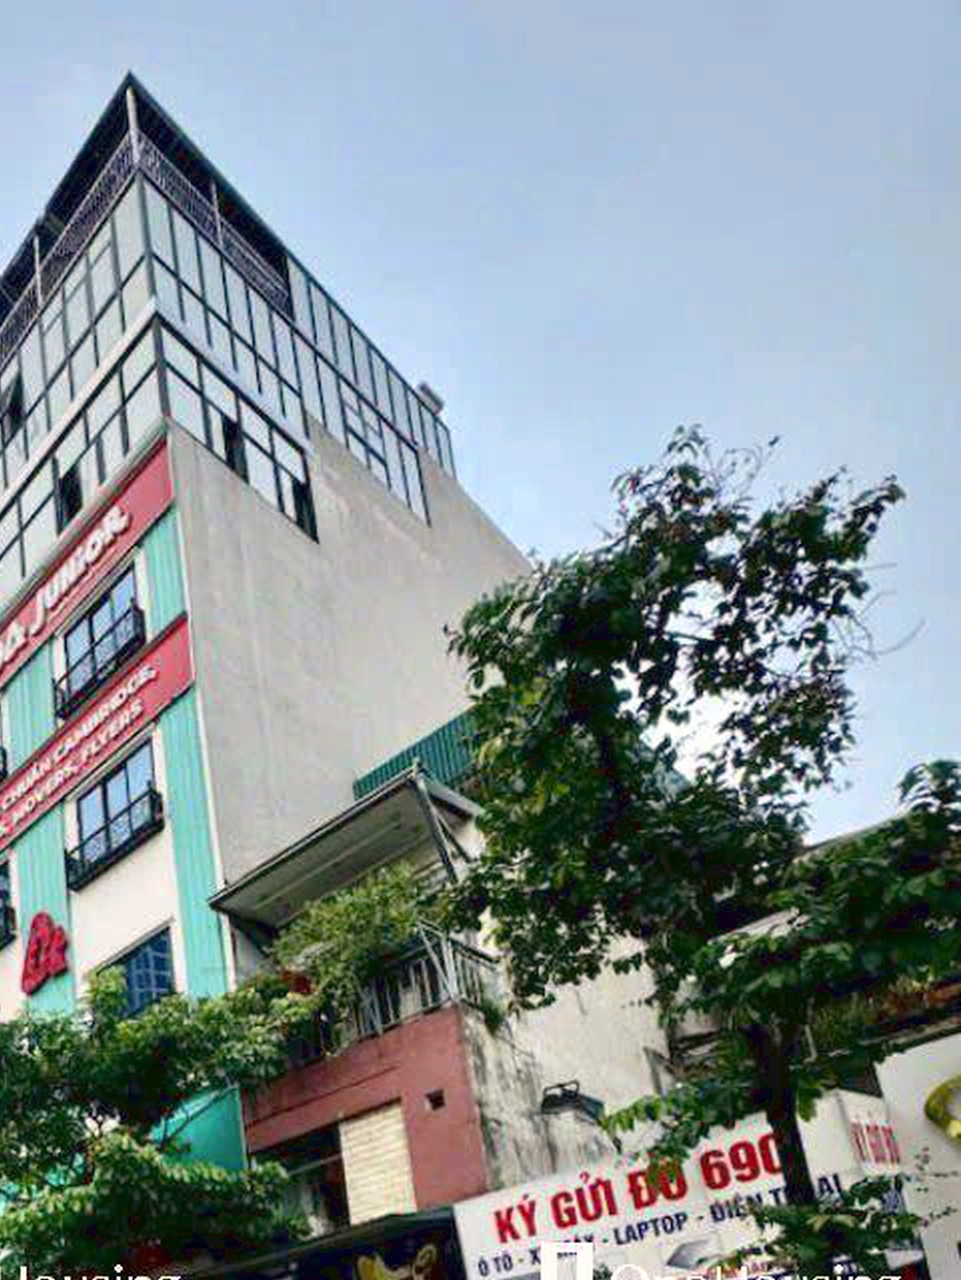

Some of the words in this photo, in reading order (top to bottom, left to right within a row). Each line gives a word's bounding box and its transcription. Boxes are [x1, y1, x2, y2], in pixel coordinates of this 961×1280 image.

[29, 507, 130, 636] JUNIOR
[493, 1194, 538, 1243] KÝ
[551, 1171, 619, 1230] GỬI
[613, 1211, 689, 1246] LAPTOP
